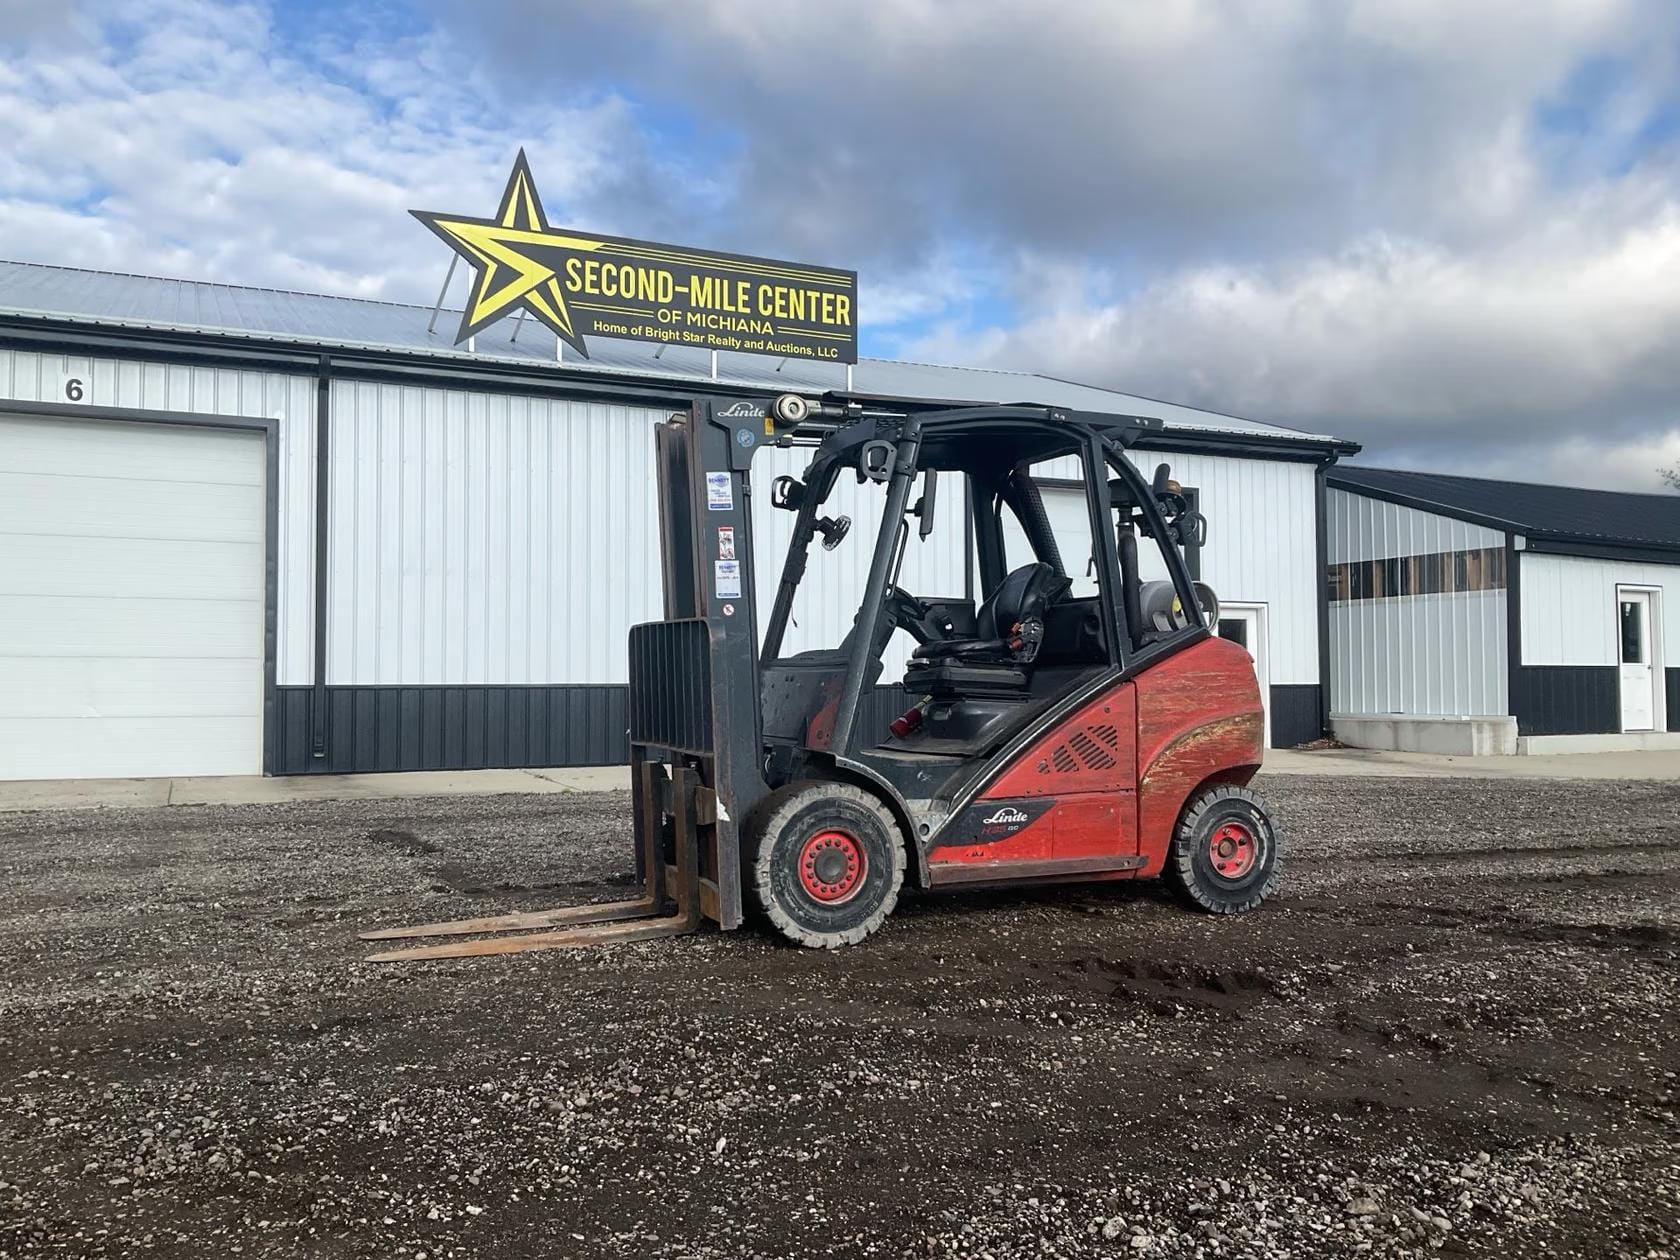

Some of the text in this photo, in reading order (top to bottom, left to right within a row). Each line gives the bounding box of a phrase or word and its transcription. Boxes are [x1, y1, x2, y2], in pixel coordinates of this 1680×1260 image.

[565, 258, 850, 326] SECOND-MILE CENTER
[658, 308, 774, 336] OF MICHIANA
[594, 320, 838, 358] Home of Bright Star Realty and Auctions, LLC
[65, 378, 83, 402] 6
[717, 401, 765, 417] Linde
[983, 807, 1028, 824] Linde
